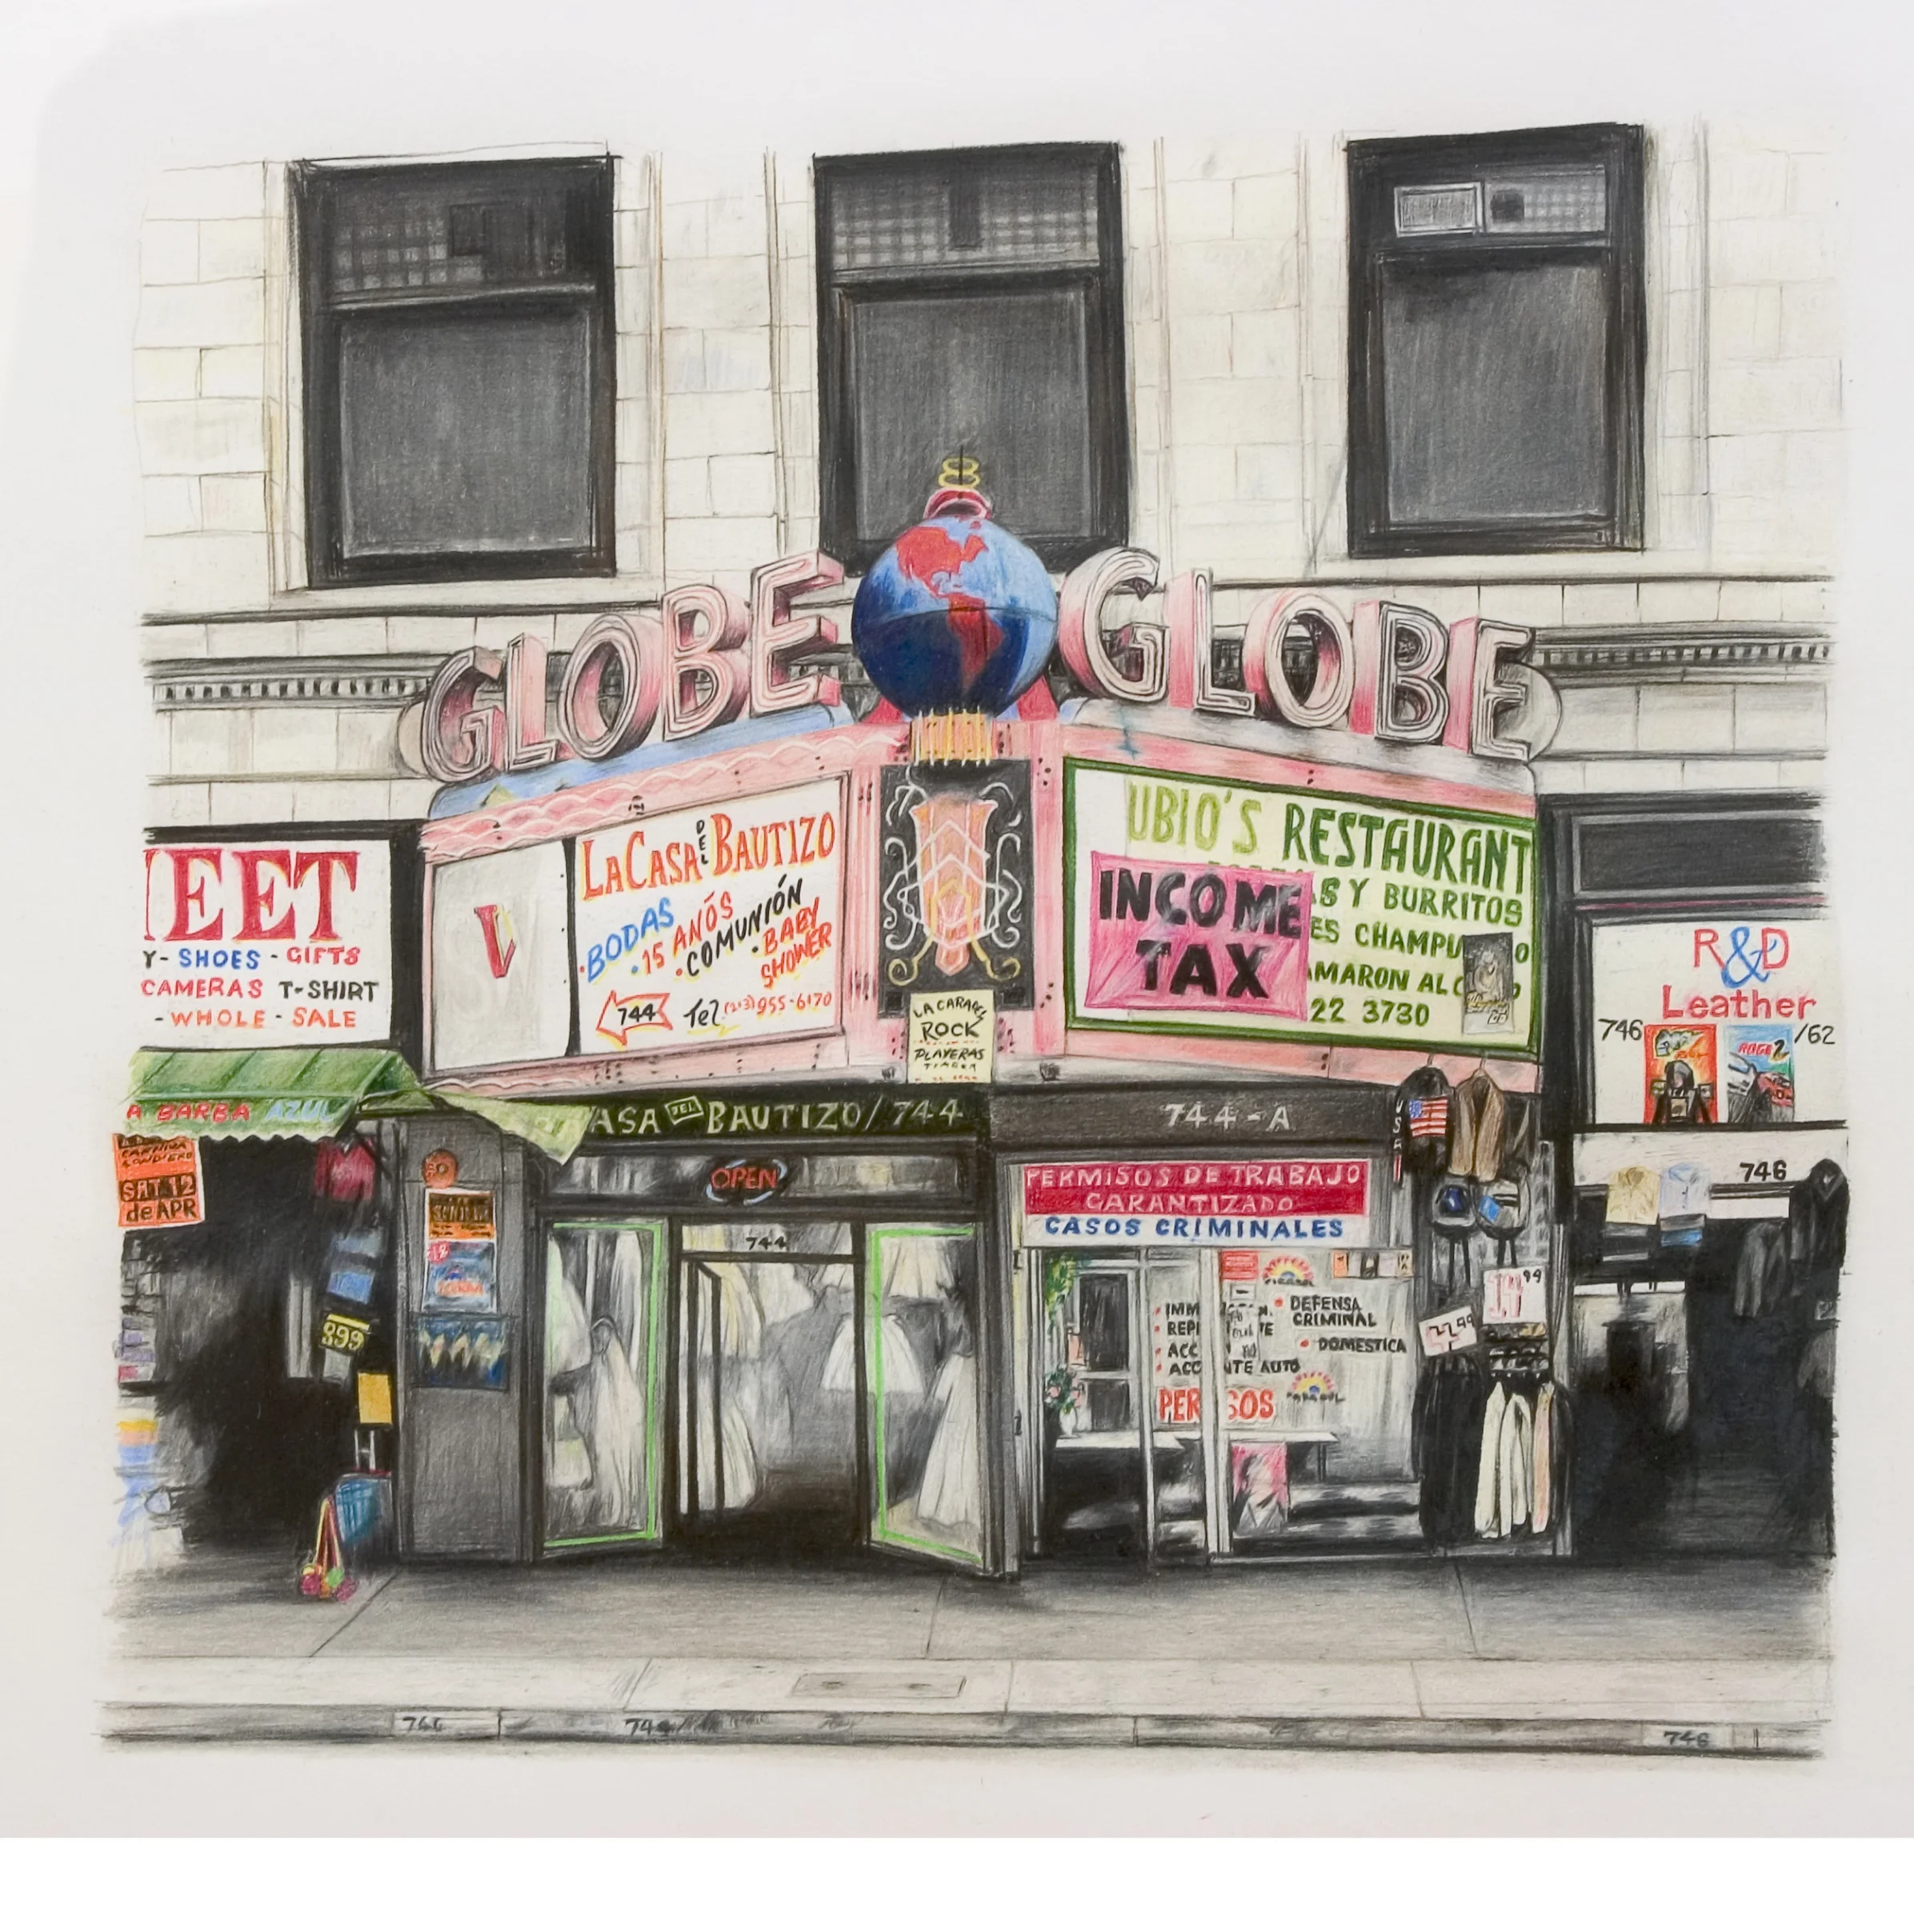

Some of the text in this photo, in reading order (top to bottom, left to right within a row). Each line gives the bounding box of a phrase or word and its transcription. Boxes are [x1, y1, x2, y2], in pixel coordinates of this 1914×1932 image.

[422, 550, 844, 782] GLOBE
[1059, 547, 1537, 761] GLOBE
[711, 813, 835, 876] BAUTIZO
[1129, 782, 1532, 894] UBIO'S RESTAURANT
[1099, 869, 1302, 939] INCOME
[1312, 877, 1524, 928] S Y BURRITOS
[763, 897, 820, 955] BABY
[587, 897, 675, 982] BODAS
[178, 948, 261, 970] SHOES
[286, 946, 362, 966] GIFTS
[643, 942, 665, 974] 15
[761, 922, 832, 989] SHOWER
[1693, 926, 1791, 990] R&D
[1135, 938, 1269, 999] TAX
[1307, 960, 1411, 992] MARON
[140, 978, 380, 1002] CAMERAS T-SHIRT
[617, 1002, 657, 1026] 744
[1662, 985, 1817, 1021] Leather
[170, 1010, 266, 1030] WHOLE
[291, 1006, 357, 1029] SALE
[920, 1017, 984, 1042] ROCK
[1598, 1018, 1644, 1042] 746
[126, 1103, 142, 1120] A
[156, 1102, 251, 1122] BARBA
[710, 1166, 778, 1191] OPEN
[1184, 1165, 1219, 1185] DE
[1233, 1164, 1360, 1186] TRABAJO
[1740, 1159, 1788, 1182] 746
[122, 1179, 161, 1202] SAT
[1086, 1192, 1293, 1213] GARANTIZADO
[156, 1198, 197, 1221] APR
[1045, 1216, 1344, 1241] CASOS CRIMINALES
[745, 1236, 787, 1250] 744
[1290, 1294, 1362, 1312] DEFENSA
[1292, 1312, 1378, 1328] CRIMINAL
[321, 1322, 364, 1350] 899
[1318, 1337, 1407, 1354] DOMESTICA
[1664, 1730, 1711, 1748] 746
